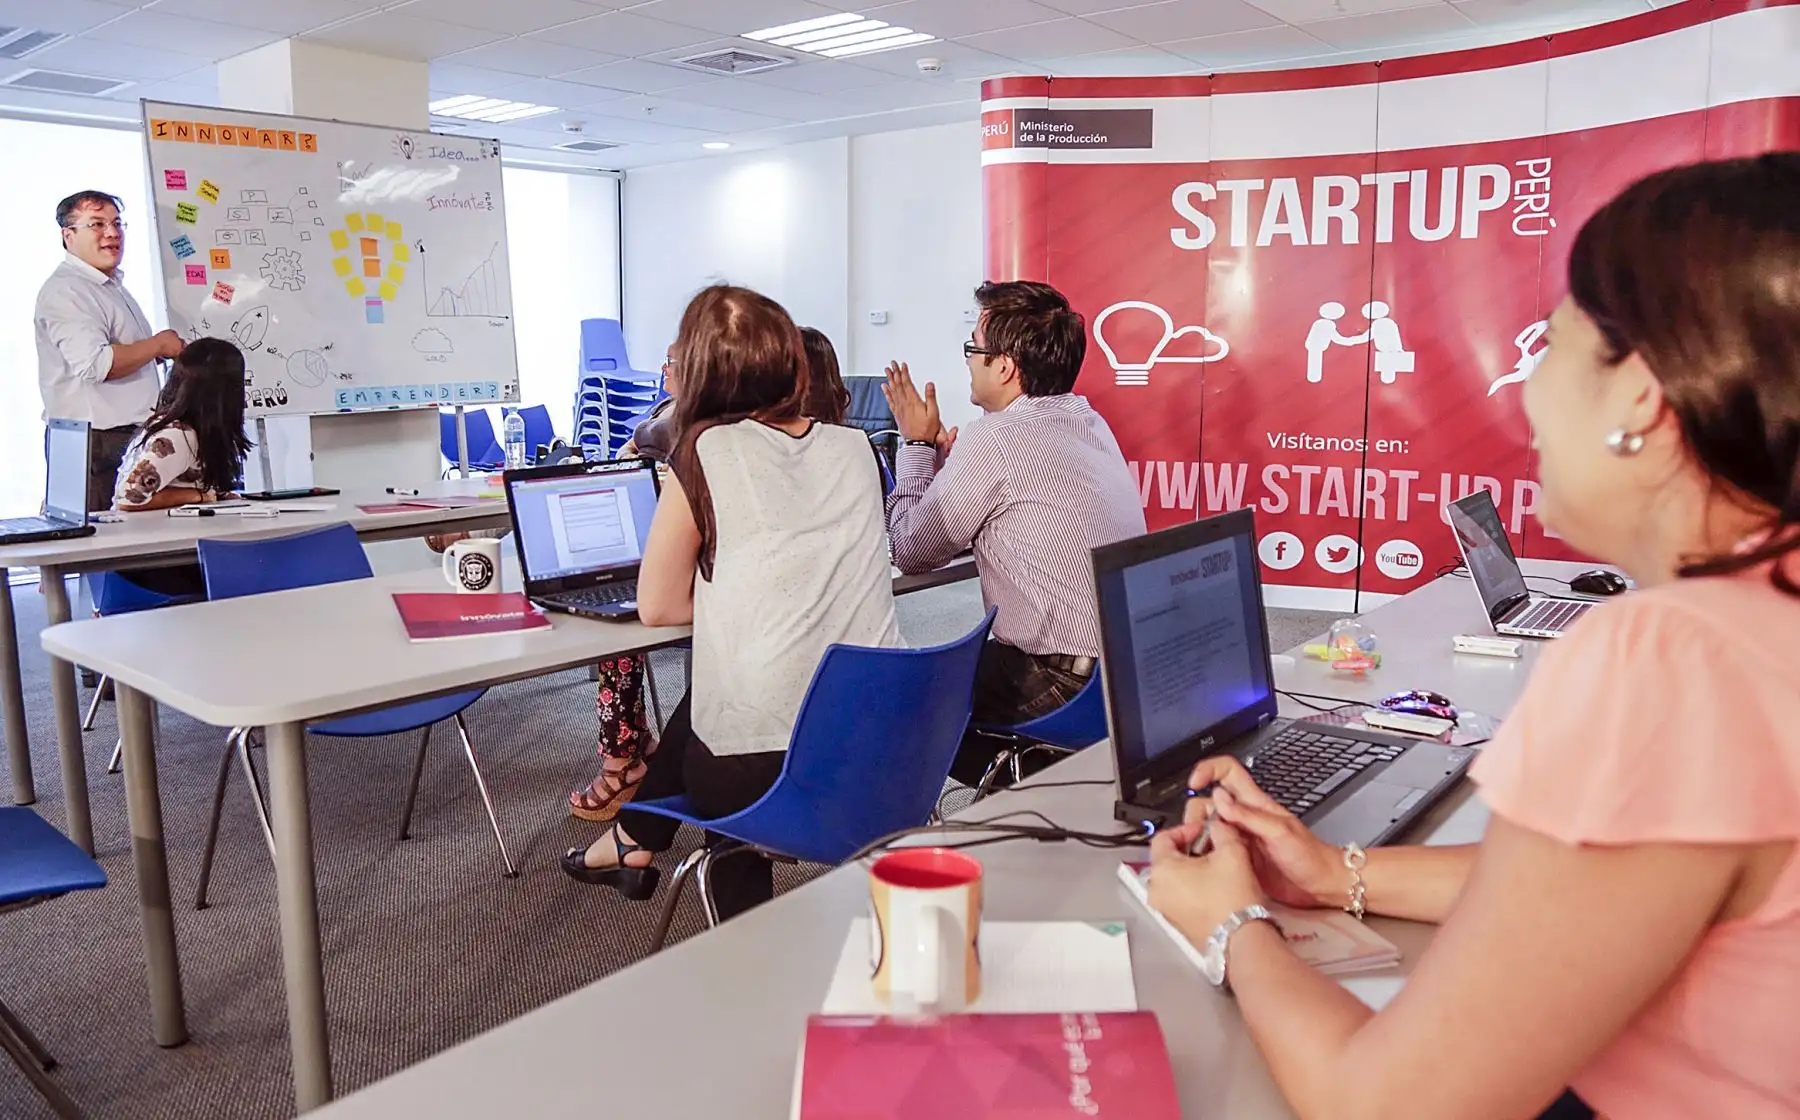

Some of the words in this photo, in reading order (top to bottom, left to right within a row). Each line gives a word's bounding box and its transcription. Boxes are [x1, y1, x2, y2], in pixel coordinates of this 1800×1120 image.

[157, 121, 312, 150] INNOVAR?
[1020, 121, 1074, 132] Ministerio
[1020, 132, 1033, 142] de
[1036, 132, 1045, 142] la
[1048, 130, 1107, 143] Producción
[1170, 164, 1511, 250] STARTUP
[1512, 157, 1557, 236] PERÚ
[340, 384, 498, 404] EMPRENDER?
[1266, 432, 1369, 452] Visítanos
[1375, 438, 1409, 454] en:
